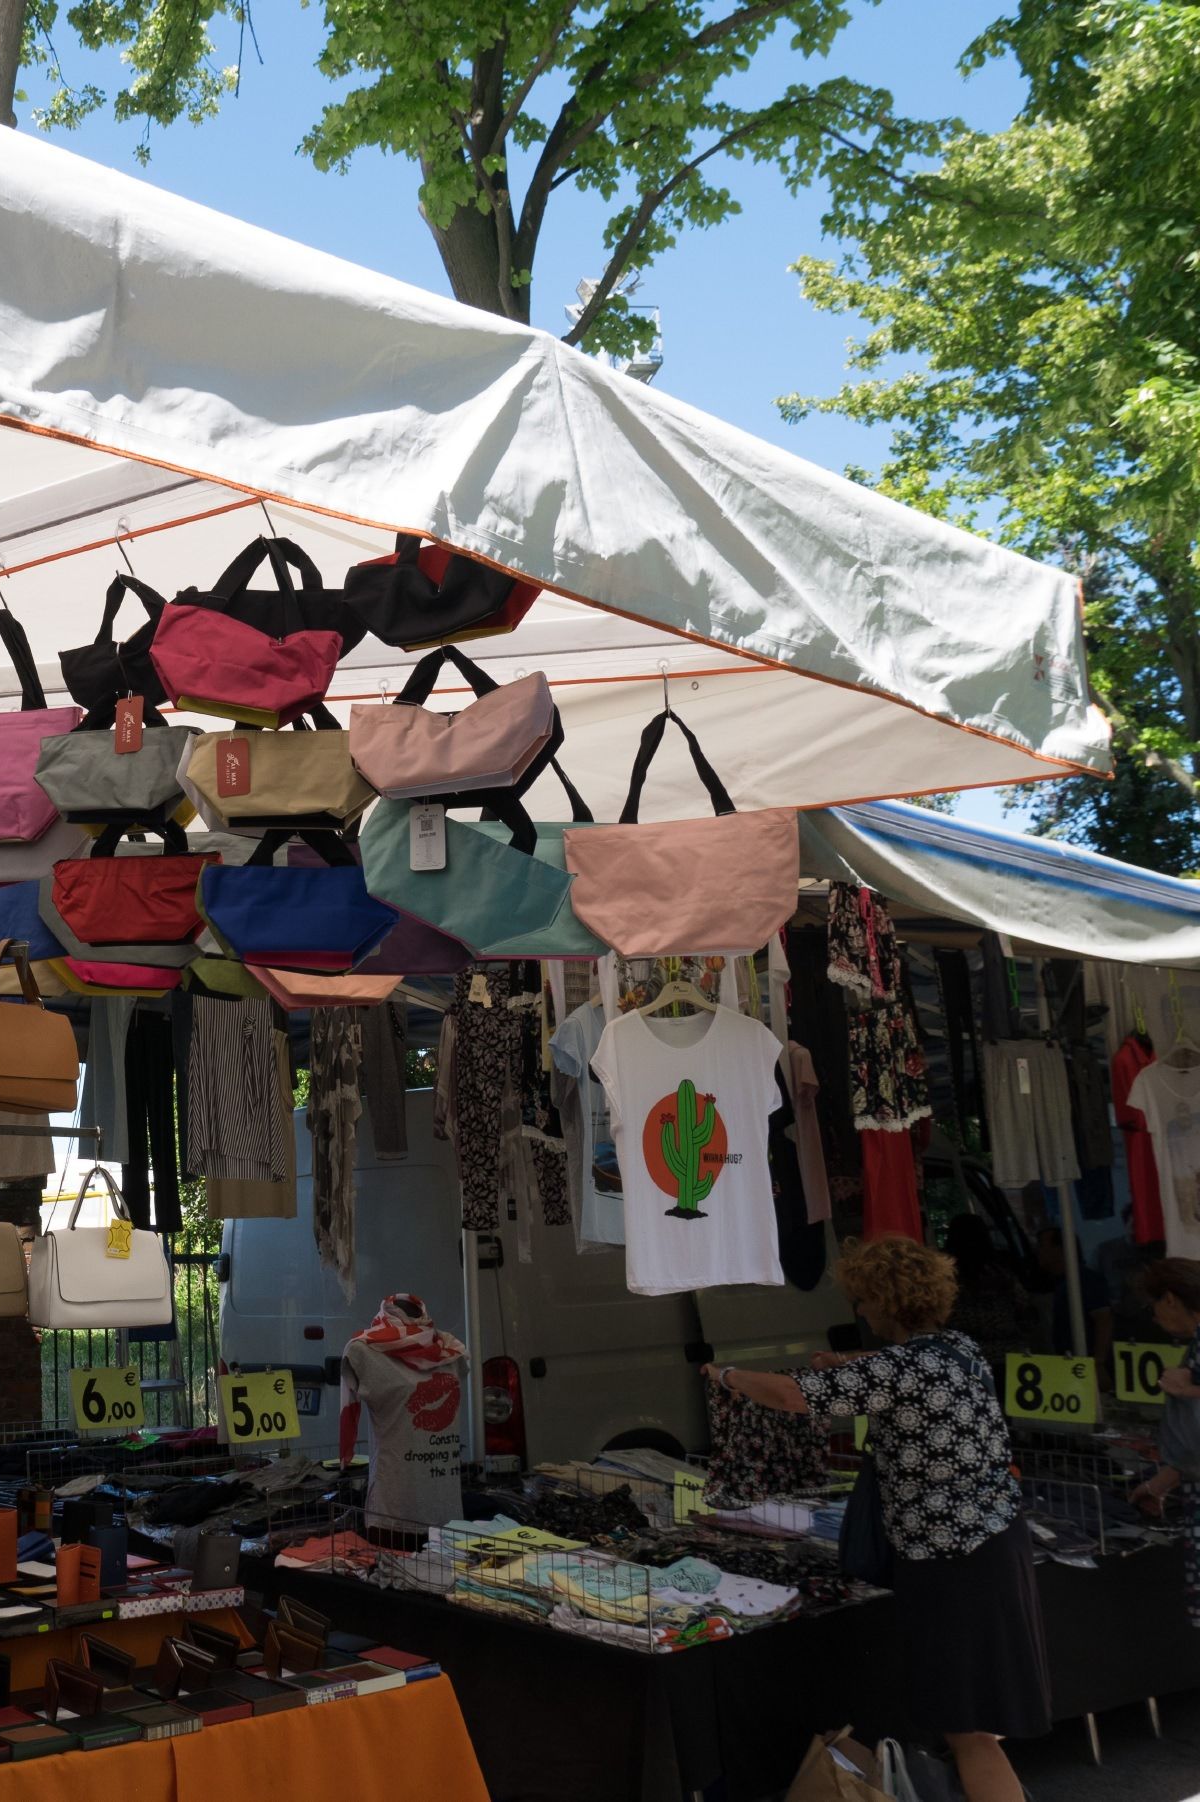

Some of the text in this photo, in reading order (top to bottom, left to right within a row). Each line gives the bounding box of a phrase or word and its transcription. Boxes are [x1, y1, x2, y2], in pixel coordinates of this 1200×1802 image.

[724, 1154, 743, 1164] HUG?
[82, 1372, 136, 1423] 6,00 €
[1015, 1362, 1086, 1414] 8,00 €
[231, 1378, 287, 1437] 5,00 €
[404, 1450, 449, 1464] dropping
[430, 1467, 446, 1478] the
